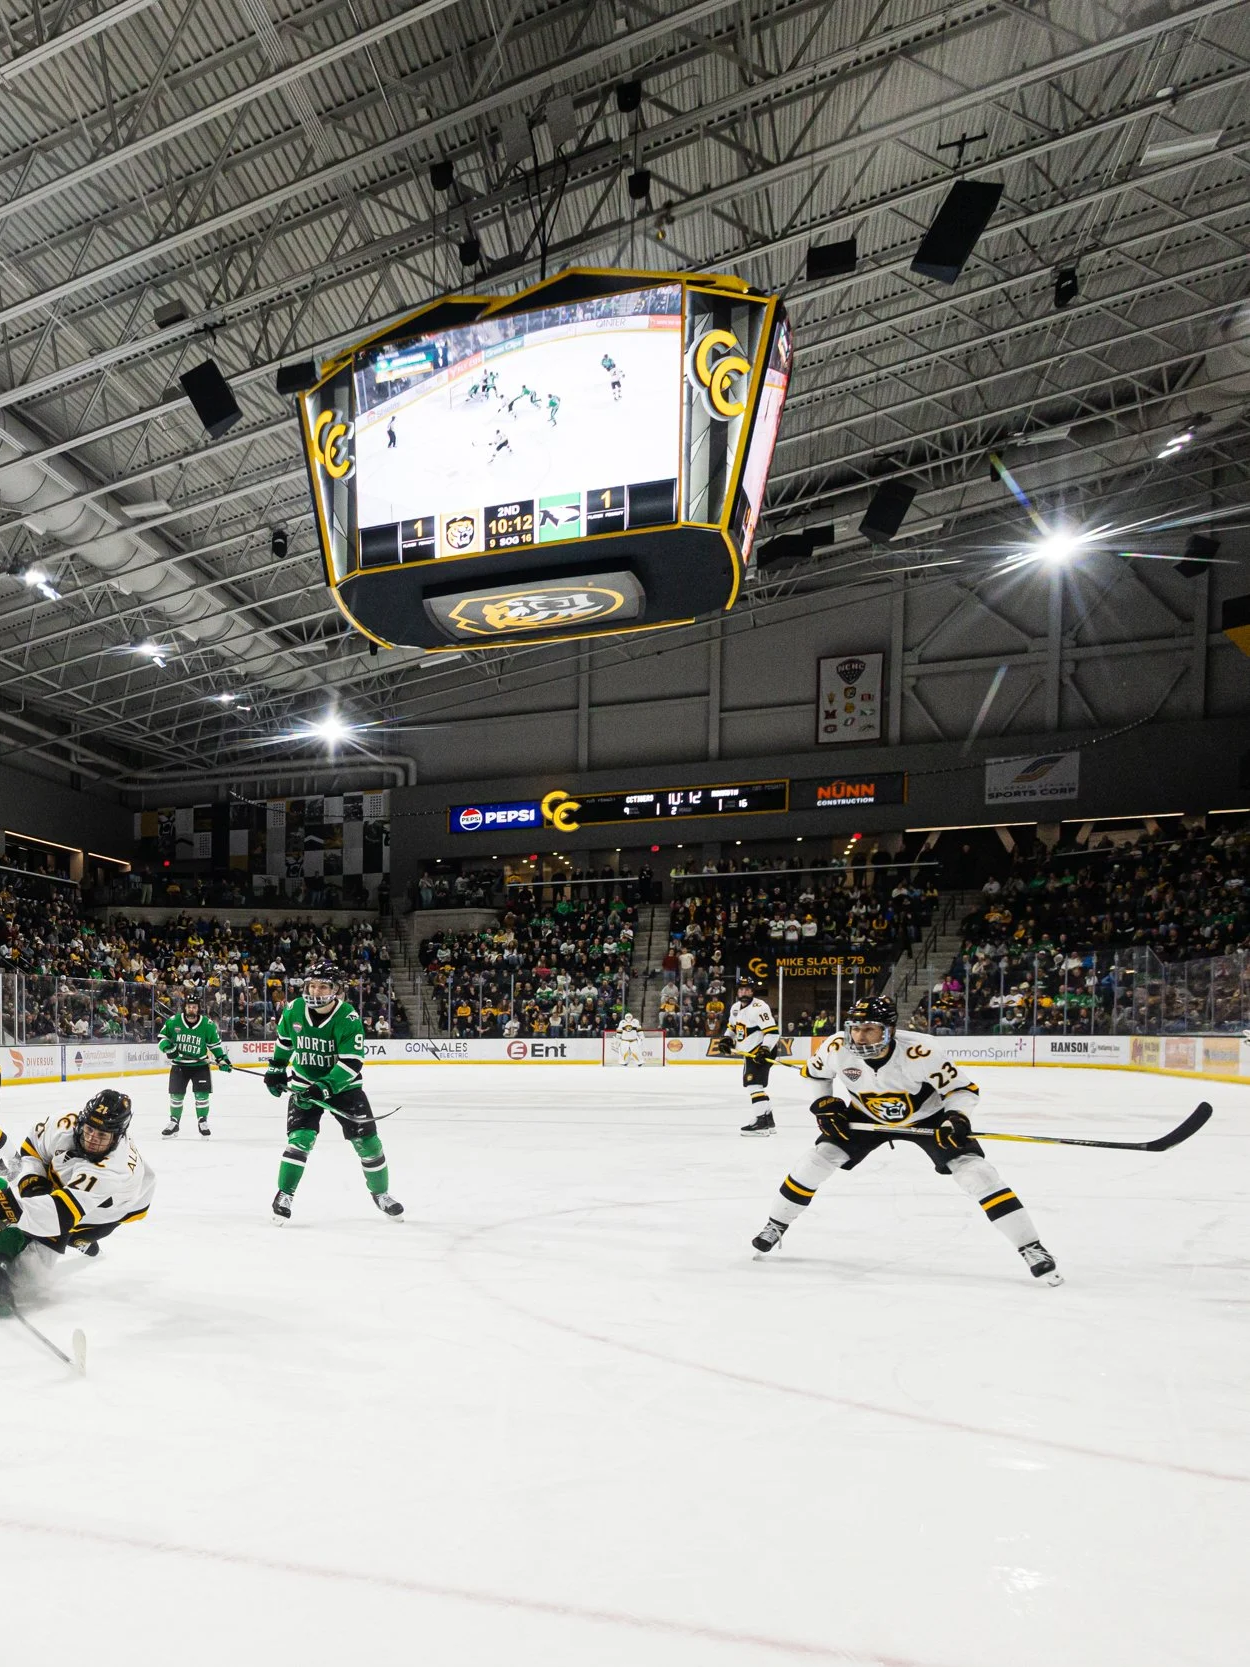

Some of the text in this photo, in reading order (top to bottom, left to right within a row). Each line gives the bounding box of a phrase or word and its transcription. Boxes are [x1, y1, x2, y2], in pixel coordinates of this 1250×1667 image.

[601, 489, 612, 509] 1
[497, 504, 520, 518] 2ND
[413, 520, 423, 537] 1
[488, 514, 533, 535] 10:12
[489, 533, 533, 548] 9 SOG 16
[988, 787, 1076, 800] SPORTS CORP
[817, 797, 875, 806] CONSTRUCTION
[485, 809, 535, 824] PEPSI
[776, 956, 865, 966] MIKE SLADE '79
[776, 967, 828, 976] STUDENT
[758, 1013, 770, 1022] 18
[176, 1034, 202, 1046] NORTH
[296, 1035, 336, 1052] NORTH
[242, 1042, 275, 1053] SCHEE
[531, 1043, 567, 1057] Ent
[946, 1047, 1018, 1060] mmonSpirit
[1050, 1042, 1089, 1053] HANSON
[26, 1057, 54, 1066] DIVERSUS
[929, 1061, 958, 1089] 23
[95, 1104, 109, 1115] 21
[67, 1173, 98, 1192] 21
